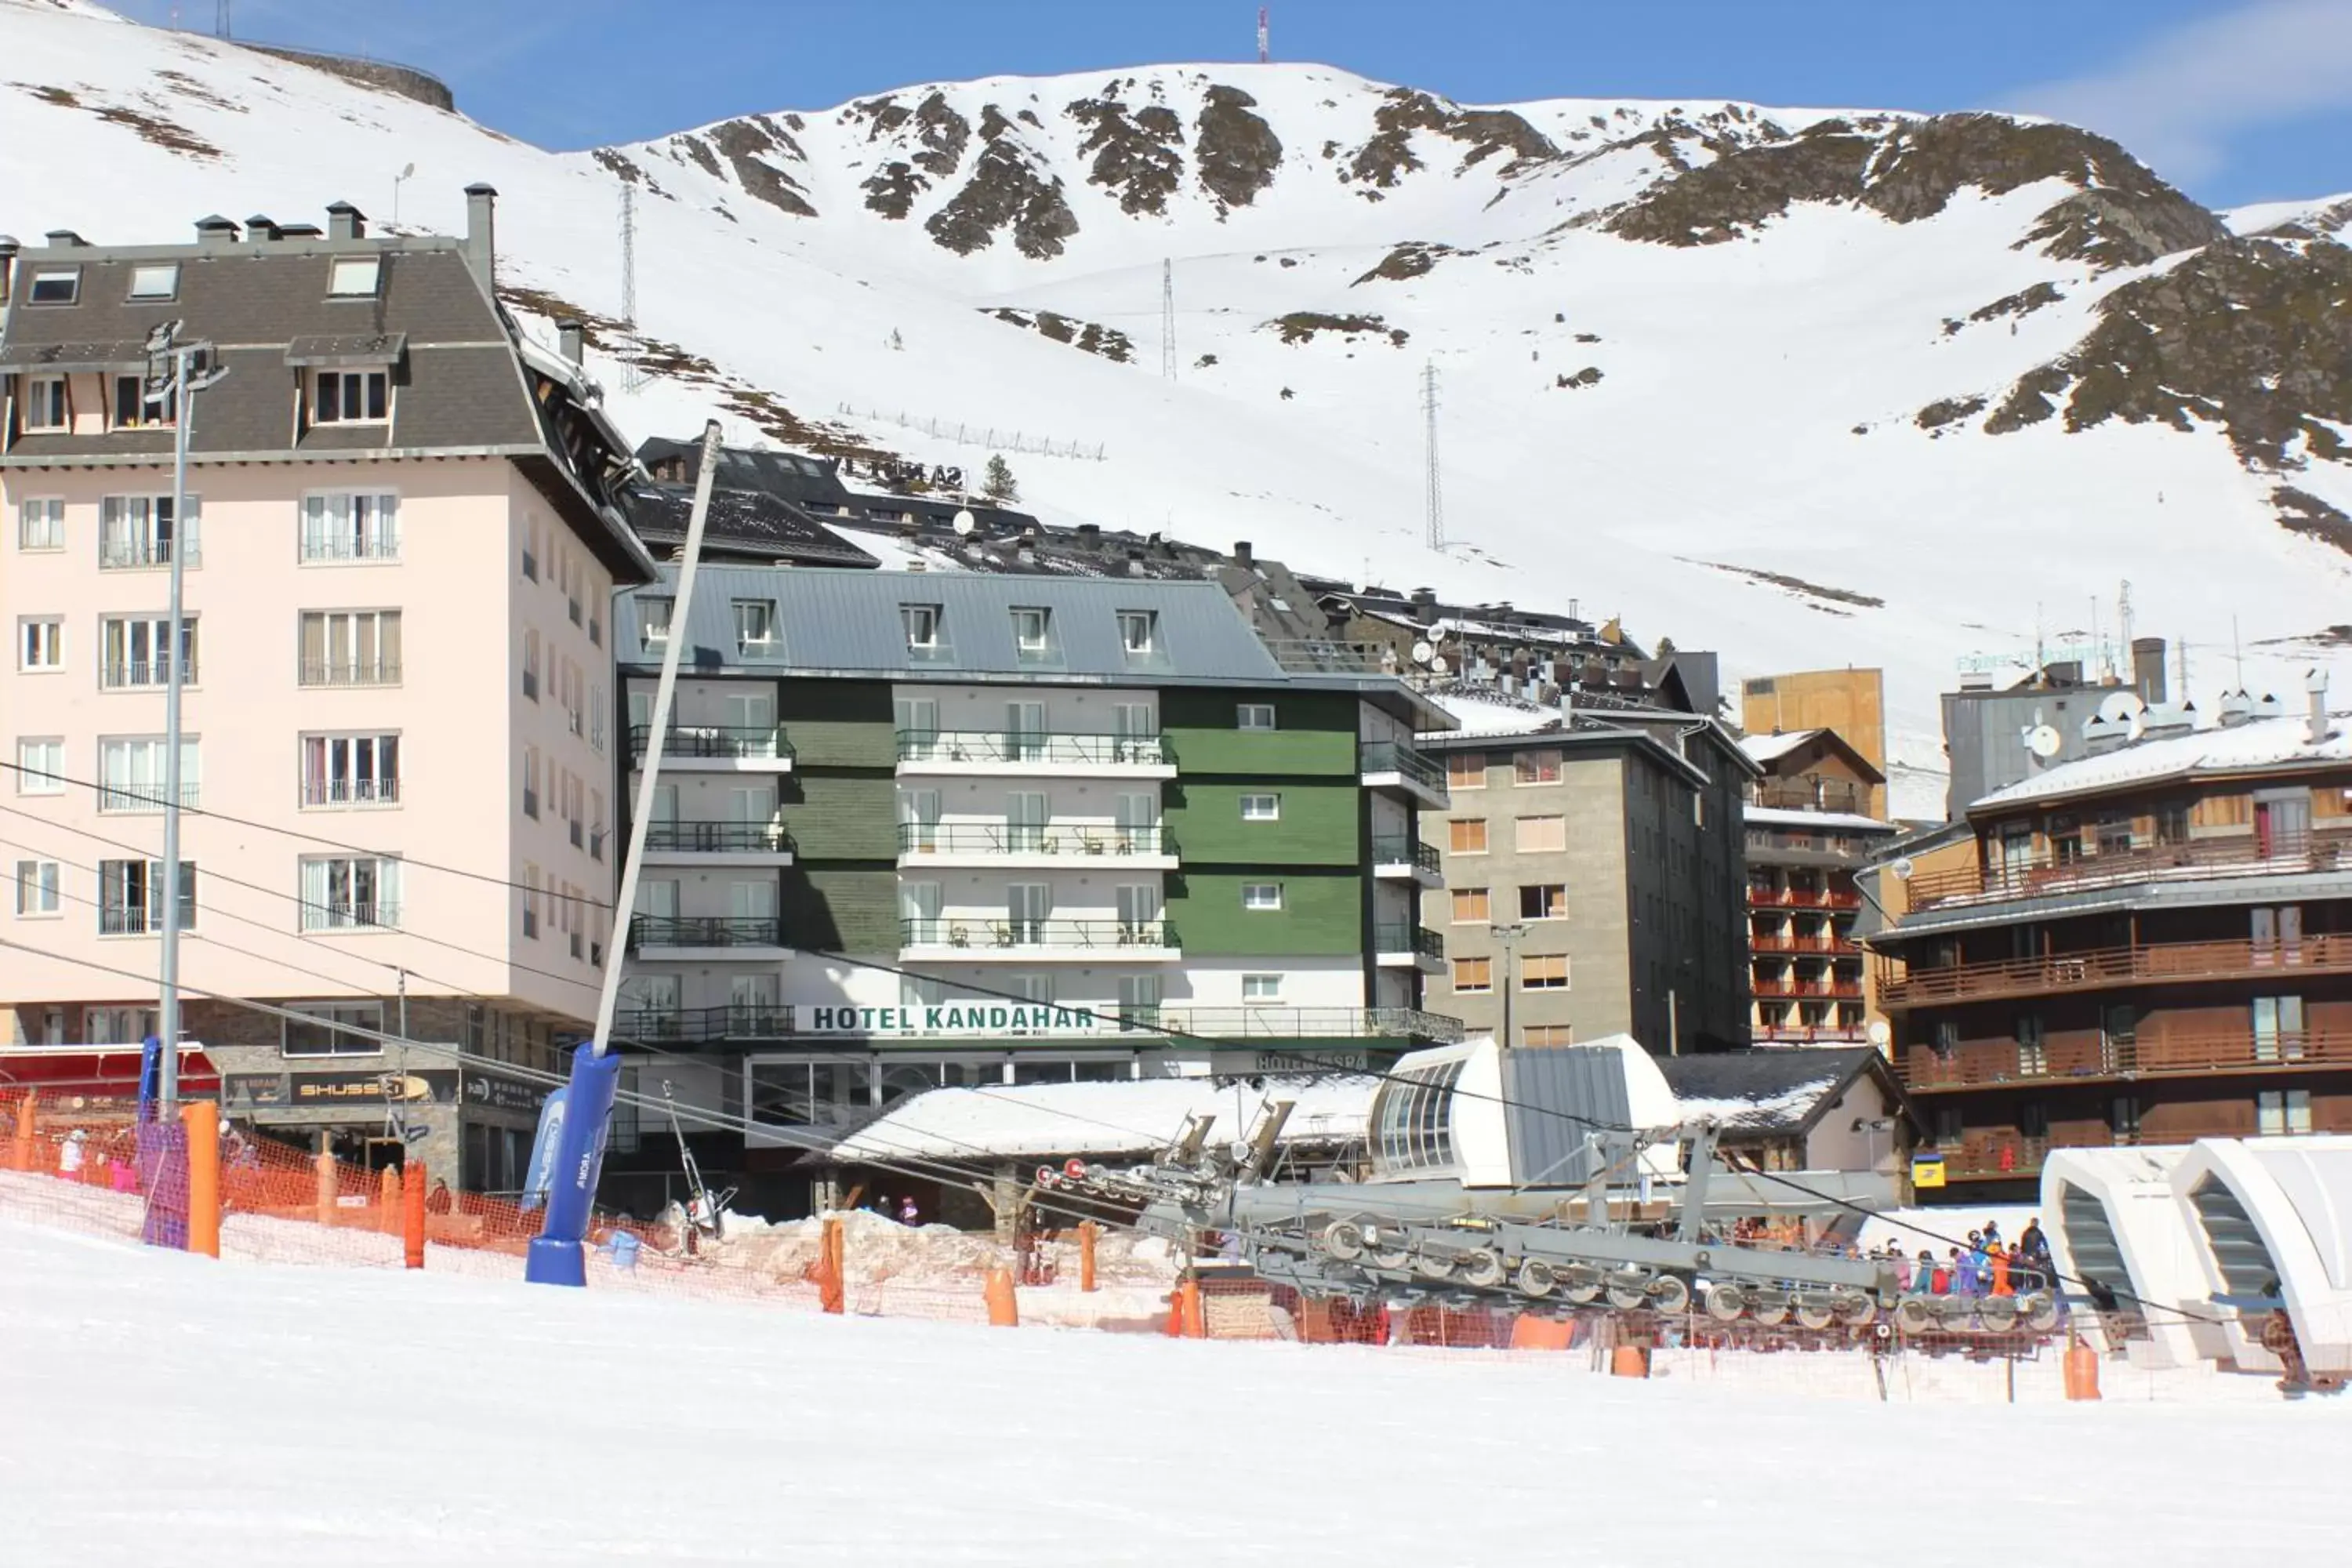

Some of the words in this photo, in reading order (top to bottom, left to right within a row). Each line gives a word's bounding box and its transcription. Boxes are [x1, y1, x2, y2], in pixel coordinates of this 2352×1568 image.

[814, 1007, 914, 1029] HOTEL
[926, 1007, 1093, 1029] KANDAHAR
[1334, 1054, 1368, 1070] SPA
